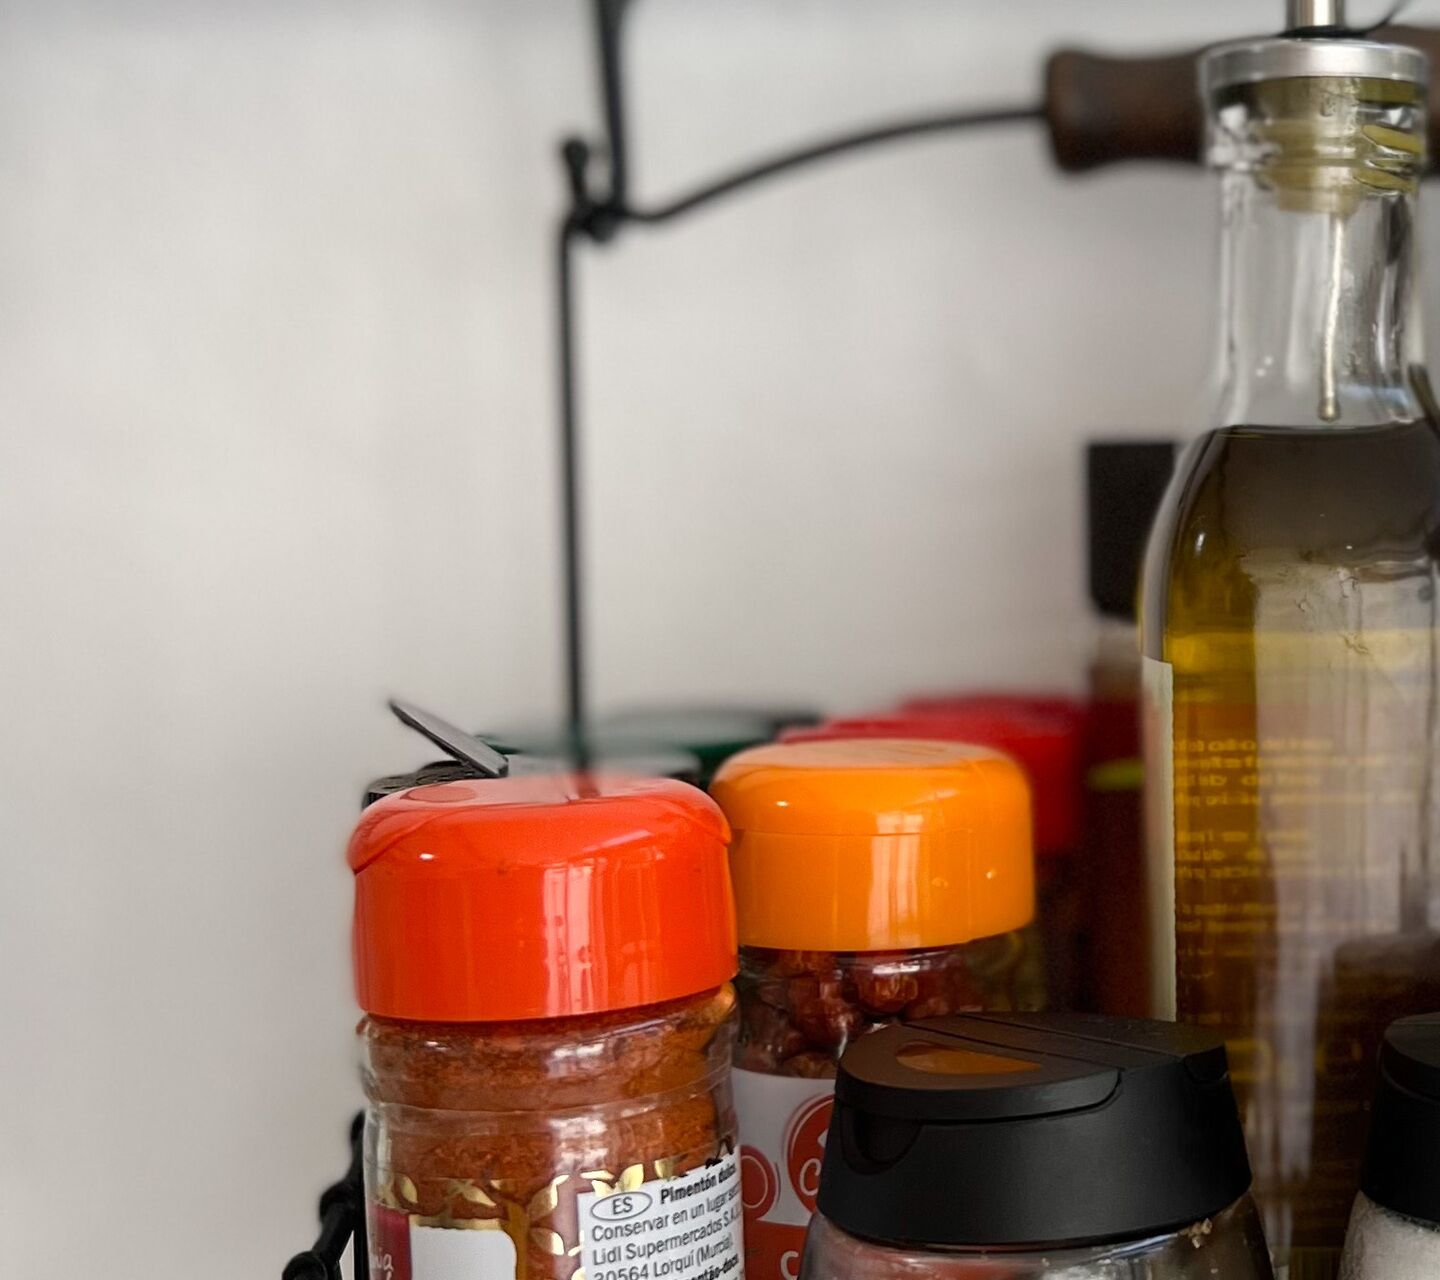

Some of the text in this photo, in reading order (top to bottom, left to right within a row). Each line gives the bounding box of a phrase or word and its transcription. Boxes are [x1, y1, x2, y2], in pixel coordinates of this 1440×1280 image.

[660, 1173, 717, 1204] Pimentón
[612, 1197, 633, 1215] ES
[592, 1214, 670, 1242] Conservar
[673, 1209, 688, 1226] en
[692, 1202, 705, 1219] un
[593, 1246, 622, 1266] Lidl
[626, 1218, 723, 1261] Supermercados
[653, 1250, 695, 1277] Lorquí
